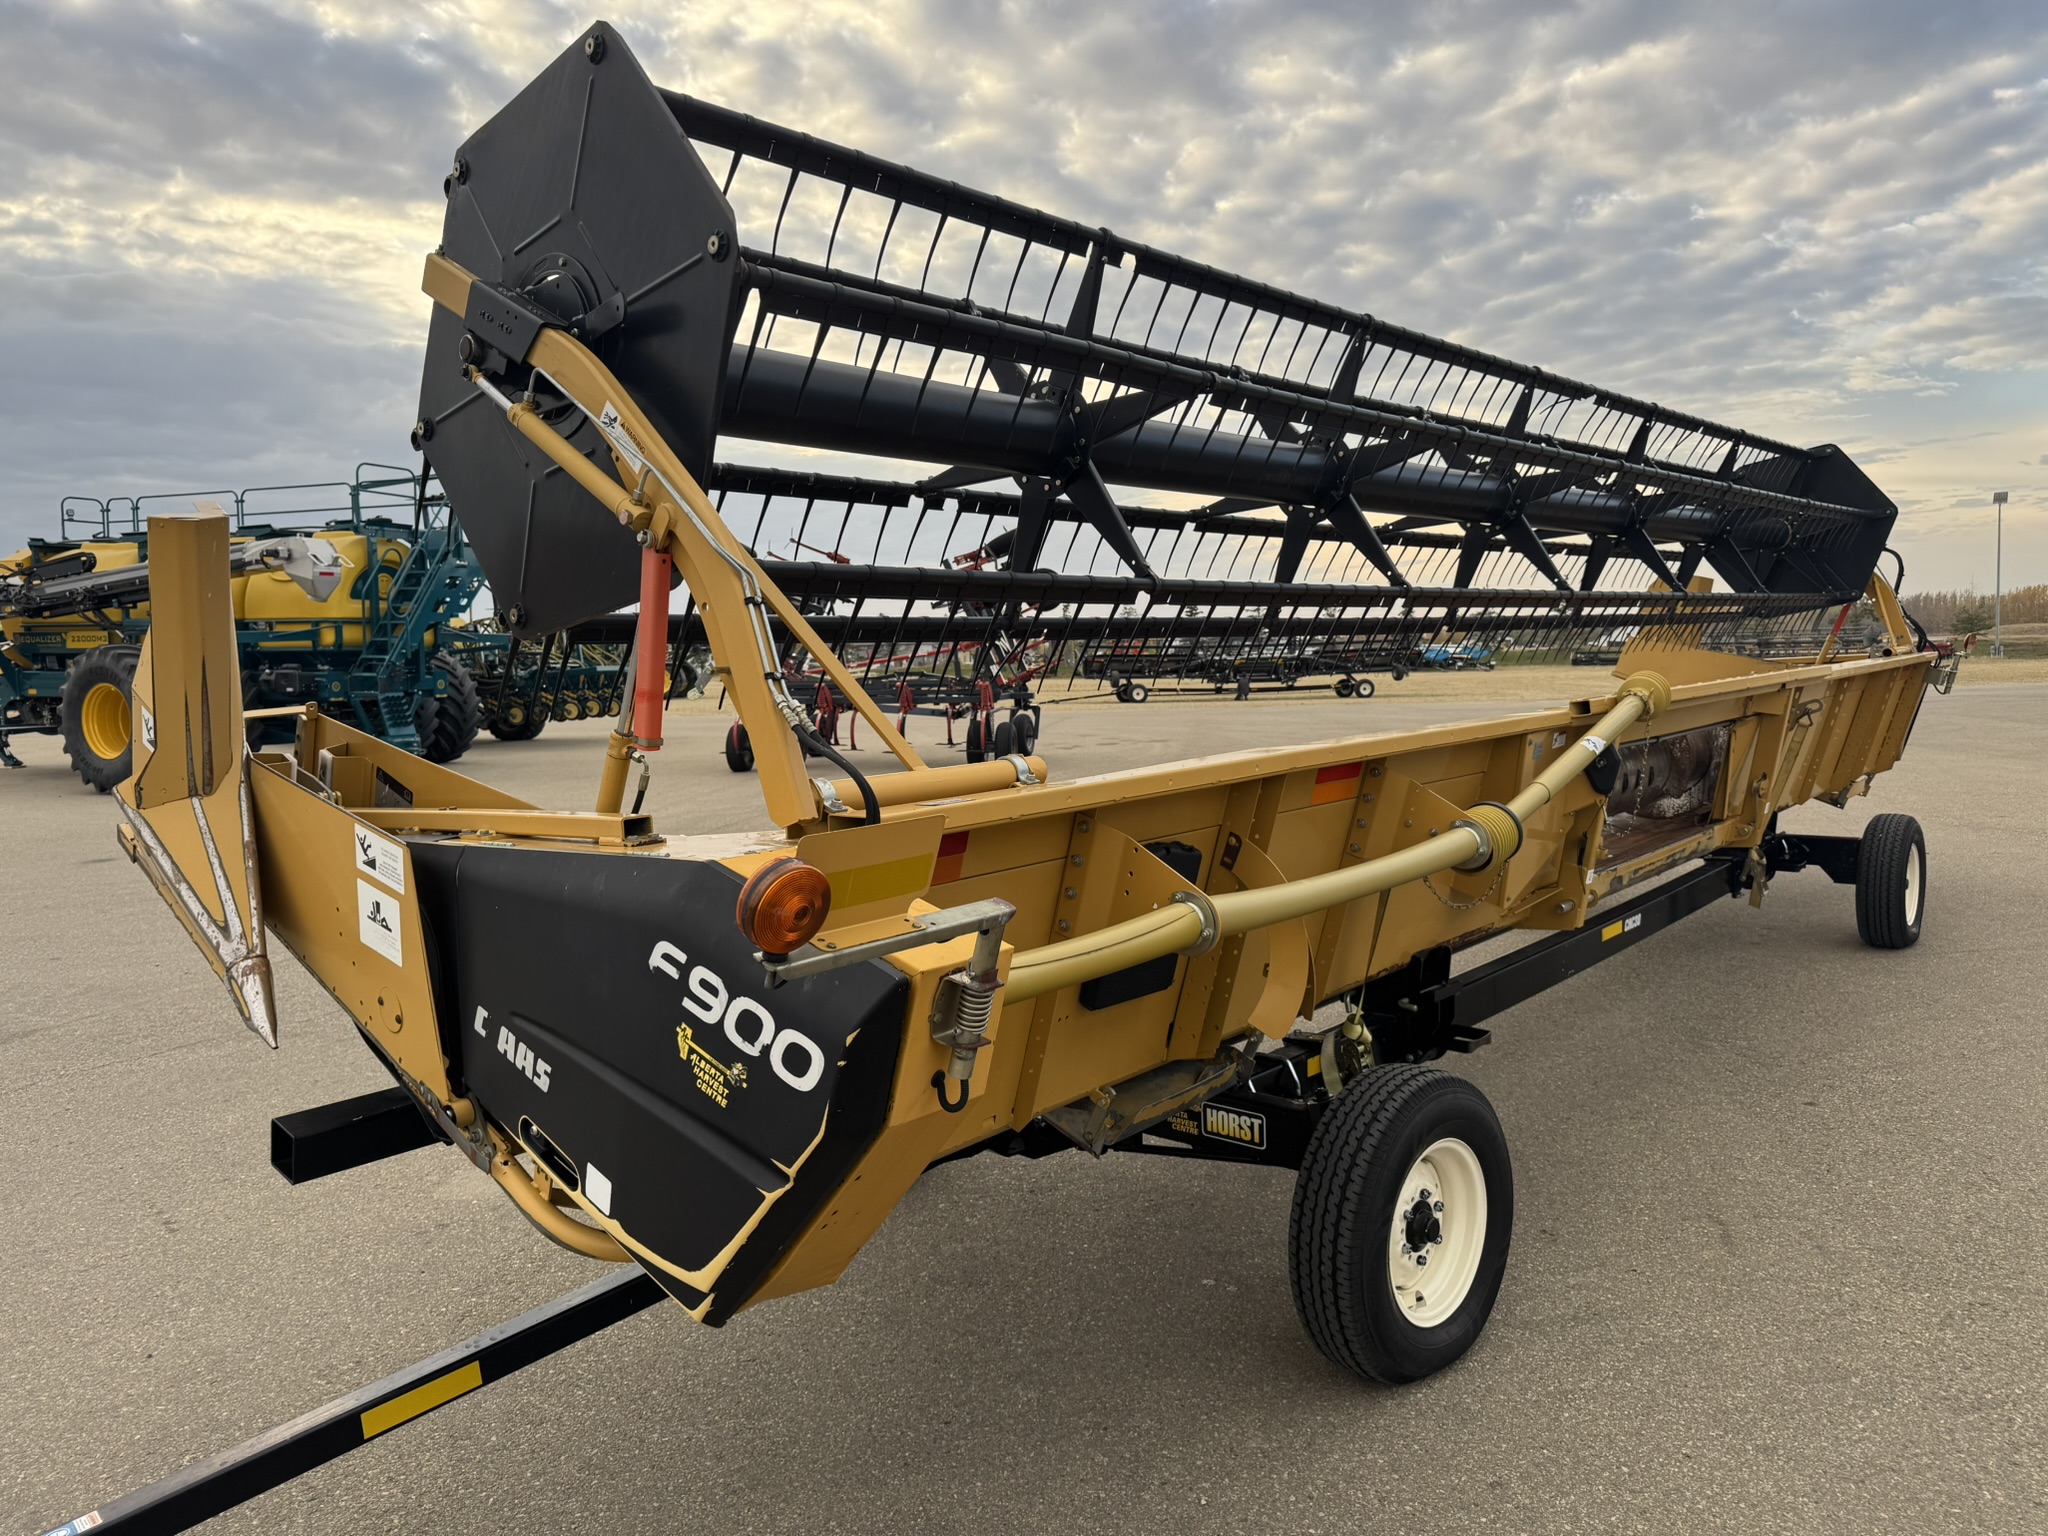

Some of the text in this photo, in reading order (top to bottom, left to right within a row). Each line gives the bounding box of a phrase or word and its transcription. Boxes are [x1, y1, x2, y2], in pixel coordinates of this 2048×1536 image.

[21, 635, 61, 644] EQUALIZER
[649, 940, 825, 1092] F900
[474, 1005, 552, 1093] CAAS
[690, 1053, 725, 1085] ALBERTA
[693, 1066, 729, 1097] HARVEST
[696, 1079, 728, 1108] CENTRE
[1171, 1123, 1199, 1136] CENTRE
[1206, 1107, 1262, 1144] HORST
